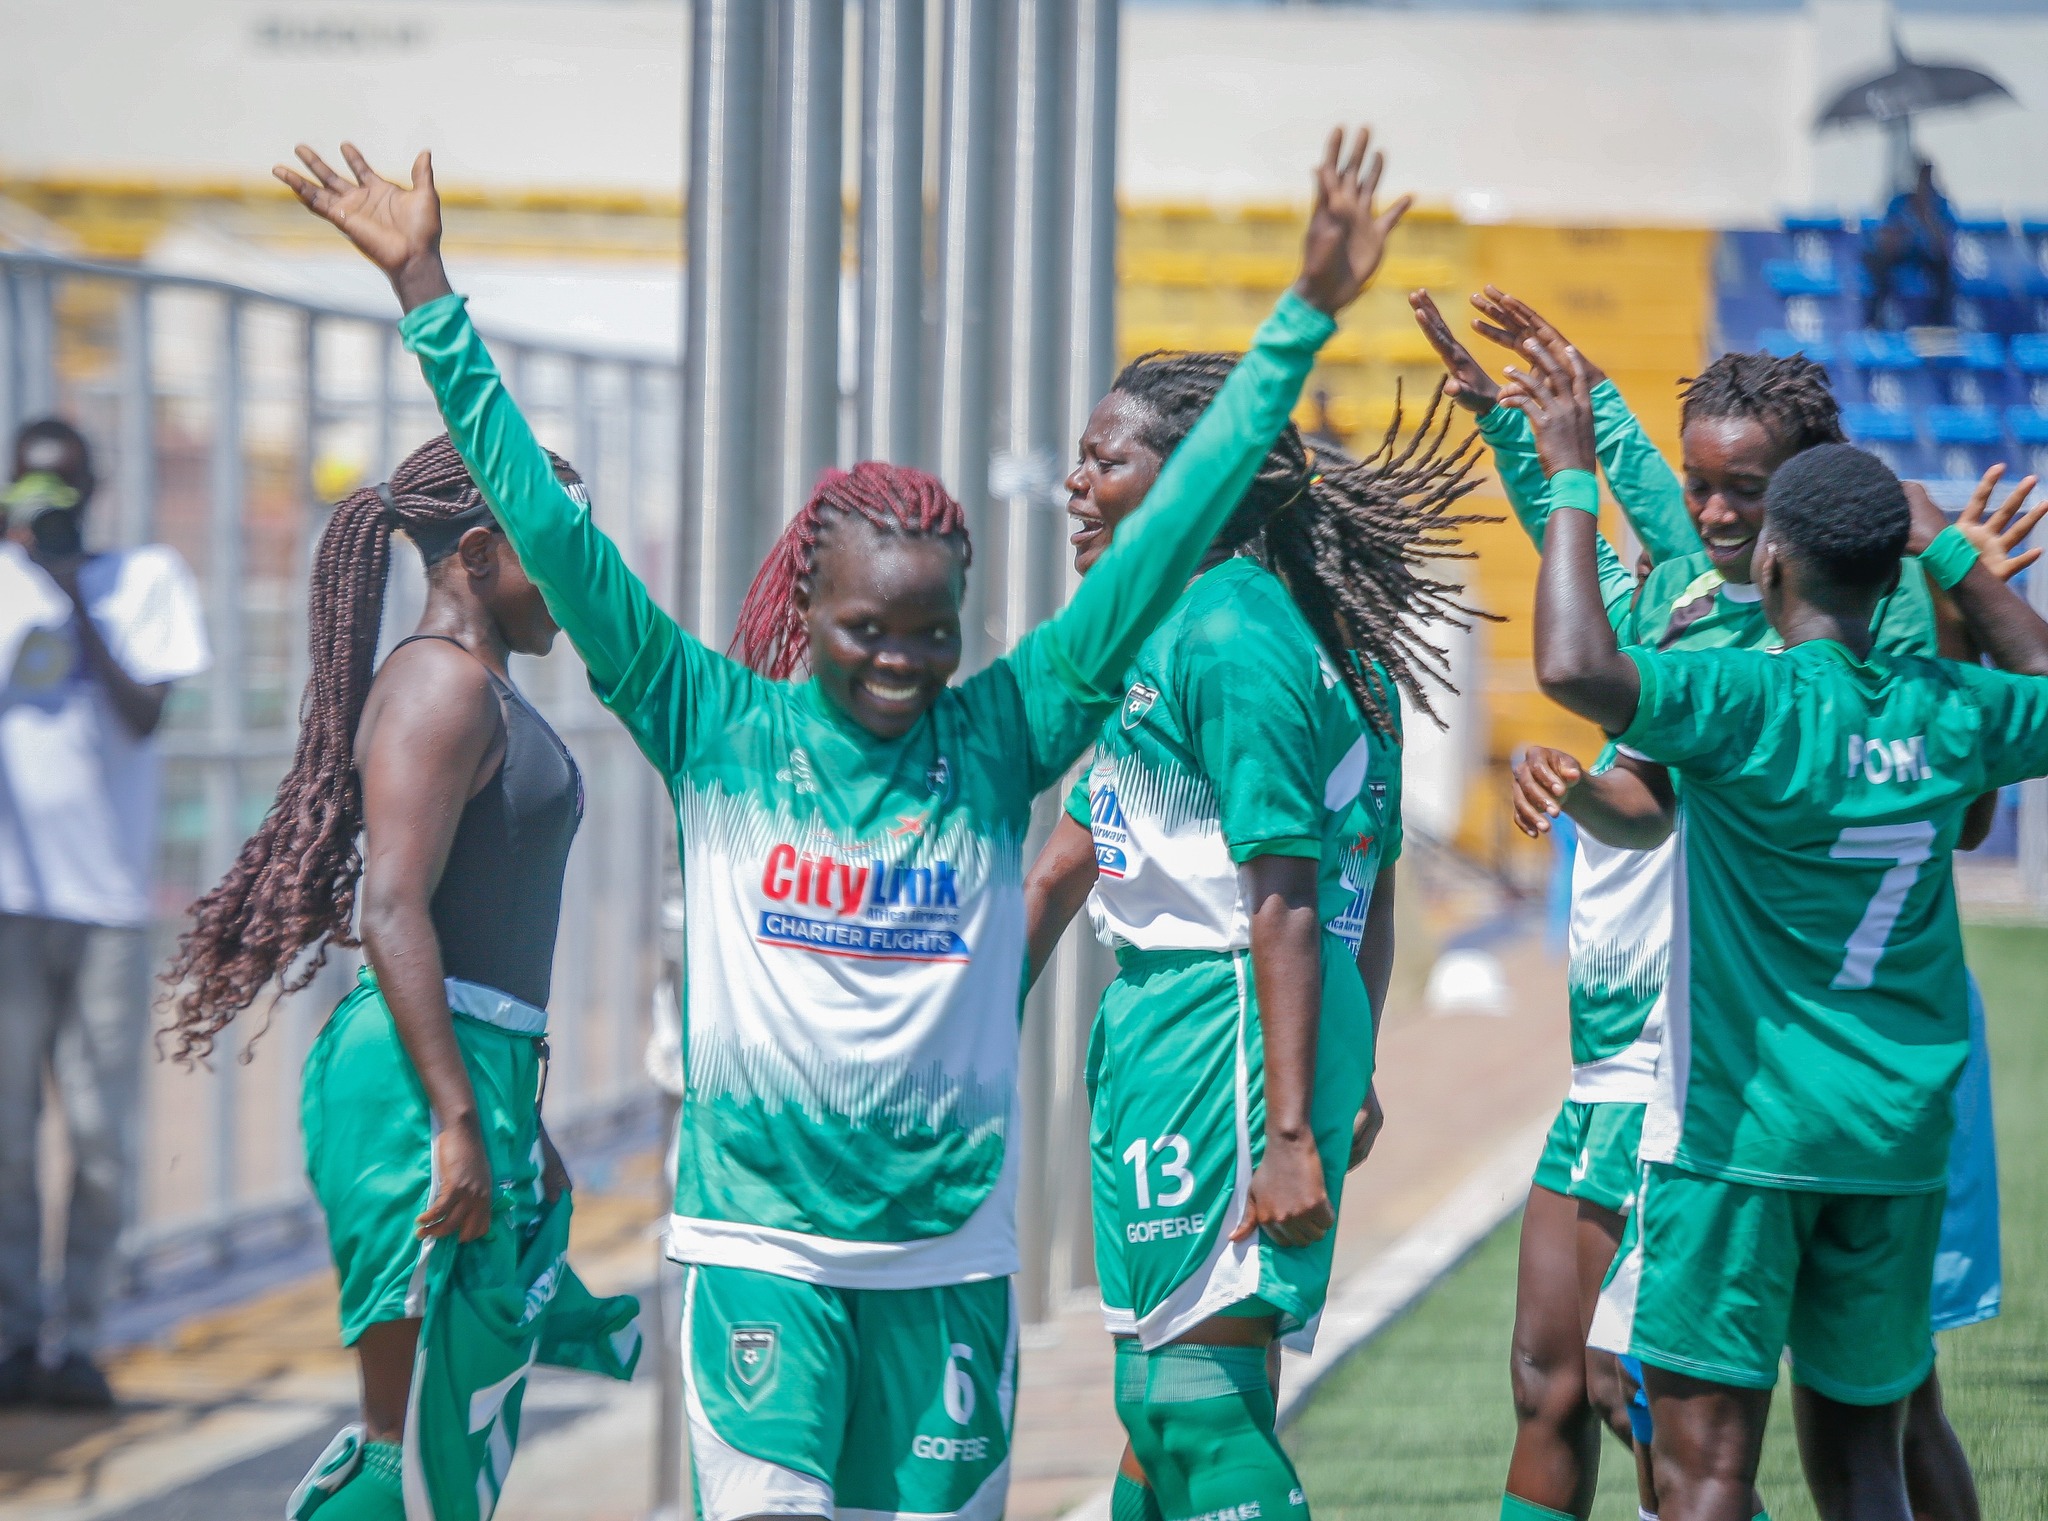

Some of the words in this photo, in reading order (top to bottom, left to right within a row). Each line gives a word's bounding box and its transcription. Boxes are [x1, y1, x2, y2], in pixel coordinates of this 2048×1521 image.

[761, 843, 959, 917] CityLink
[1828, 821, 1937, 990] 7
[766, 914, 862, 946] CHARTER
[868, 931, 951, 951] FLIGHTS
[1122, 1133, 1195, 1210] 13
[1126, 1213, 1206, 1244] GOFERE
[943, 1342, 976, 1426] 6
